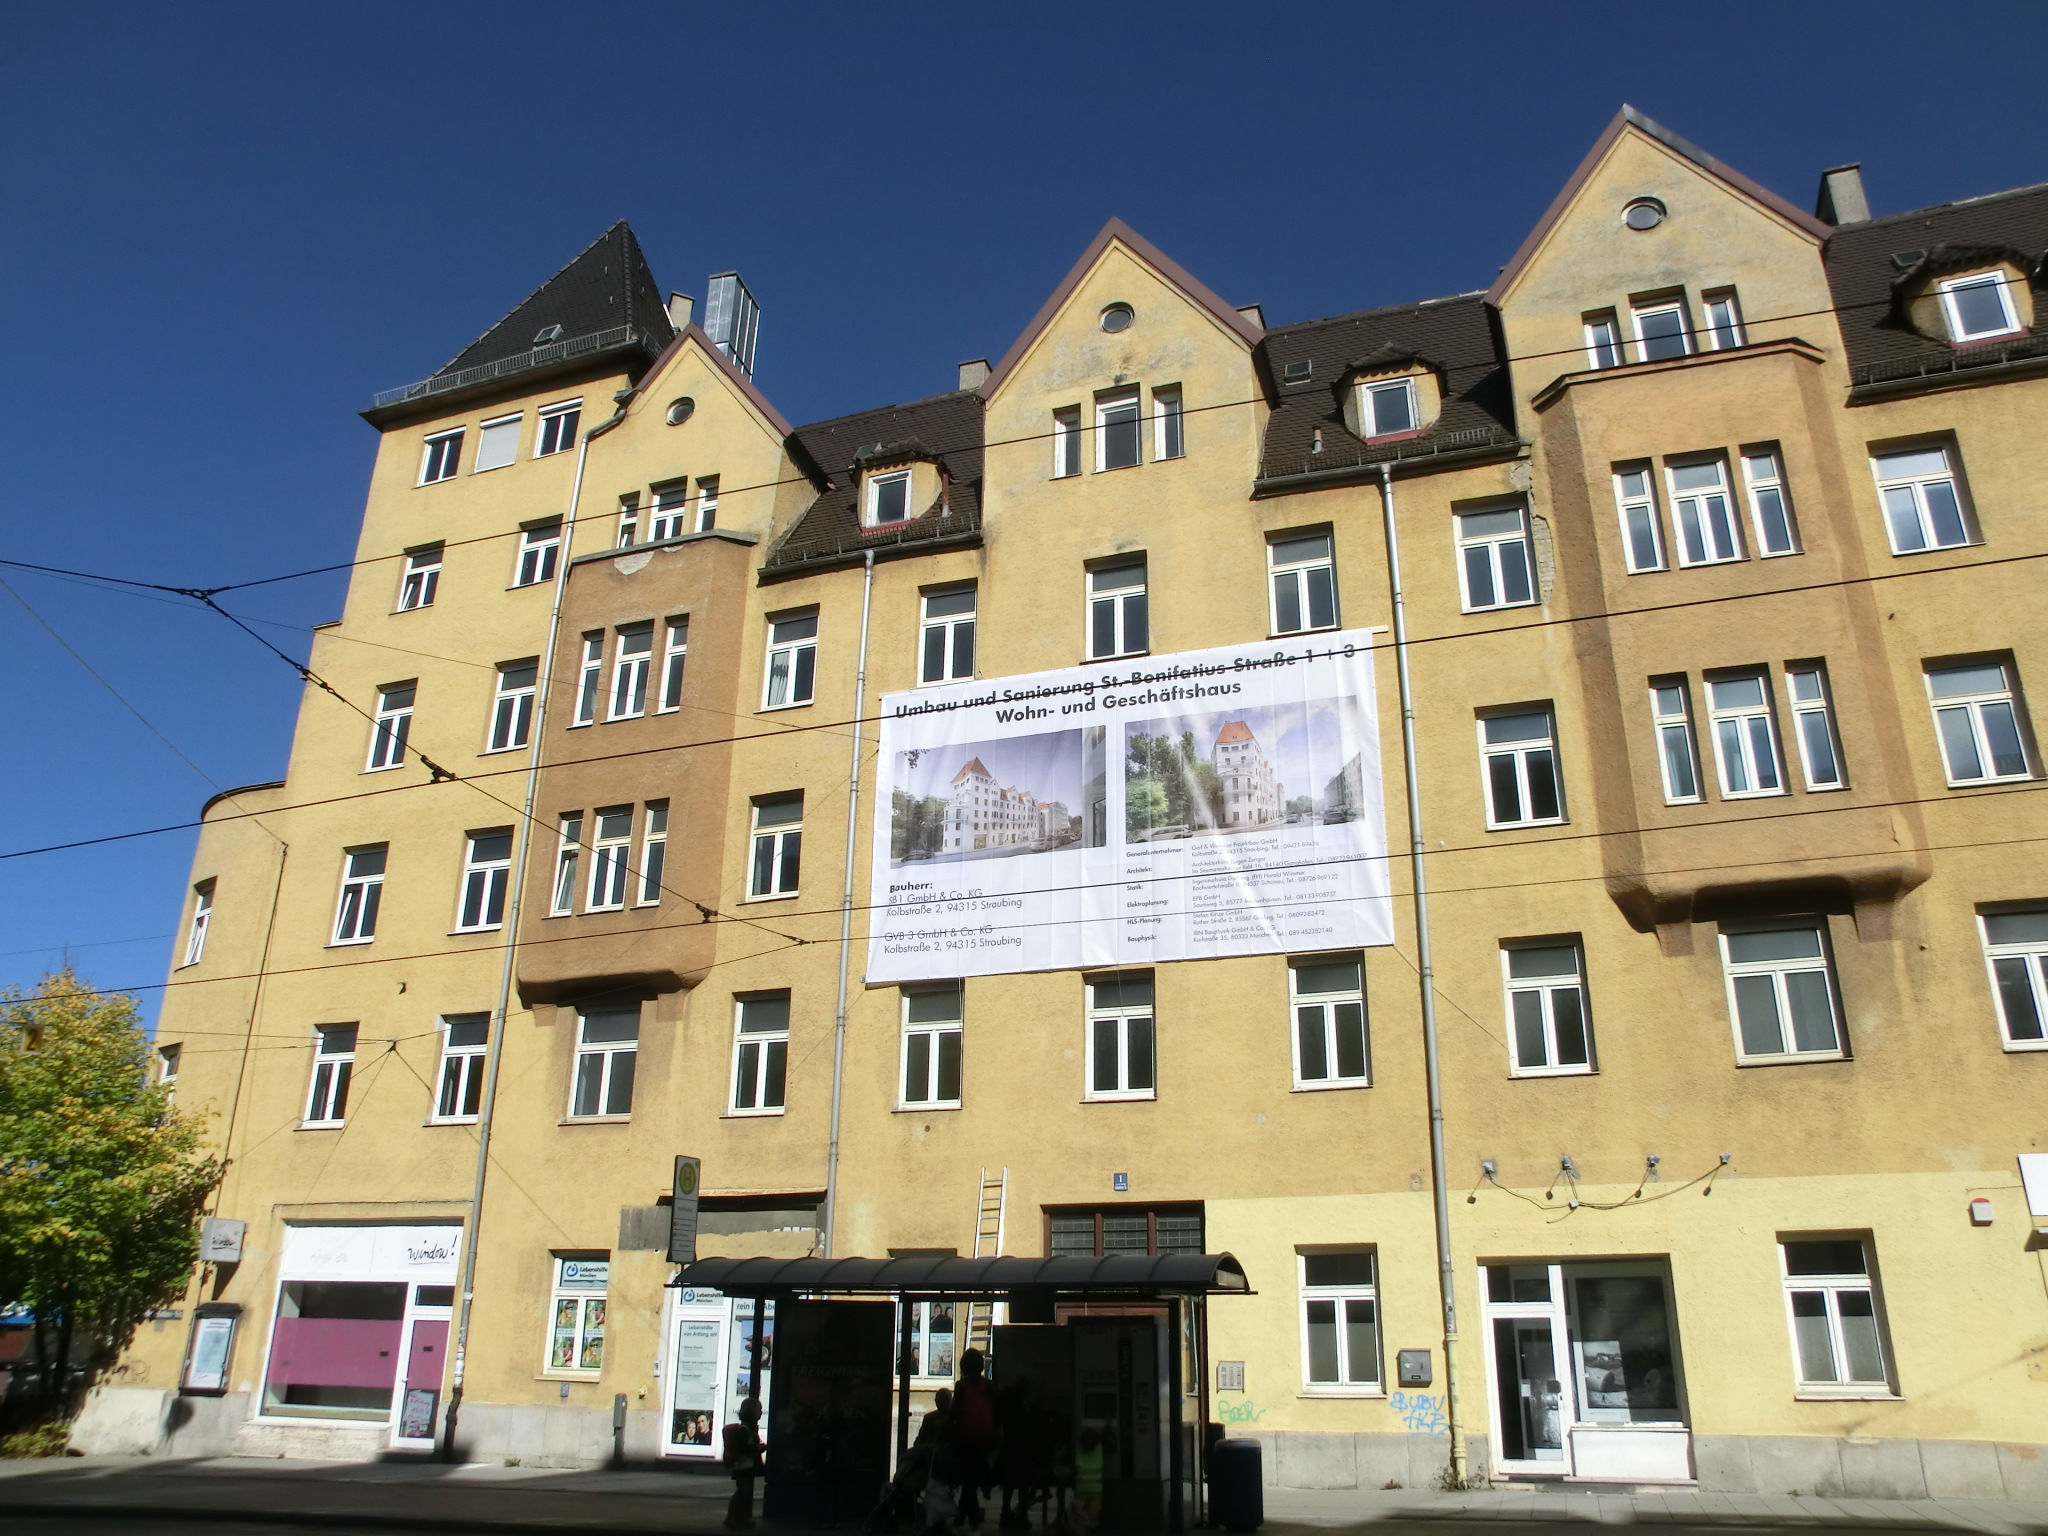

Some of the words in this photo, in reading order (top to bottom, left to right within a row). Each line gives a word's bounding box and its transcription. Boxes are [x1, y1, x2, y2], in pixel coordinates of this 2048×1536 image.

[896, 700, 957, 719] Umbau
[964, 691, 996, 707] und
[1003, 682, 1094, 702] Sanierung
[1305, 649, 1312, 662] 1
[1344, 644, 1355, 658] 3
[996, 704, 1054, 723] Wohn-
[1061, 696, 1096, 715] und
[1103, 682, 1241, 709] Geschäftshaus
[889, 881, 933, 893] Bauherr:
[907, 892, 936, 903] GmbH
[940, 891, 946, 901] &
[949, 890, 964, 900] Co.
[968, 888, 983, 898] KG
[886, 904, 932, 917] Kolbstraße
[935, 904, 943, 914] 2,
[947, 901, 977, 912] 94315
[981, 898, 1022, 910] Straubing
[908, 930, 914, 940] 3
[918, 929, 947, 939] GmbH
[950, 927, 957, 937] &
[961, 926, 976, 937] Co.
[980, 924, 993, 934] KG
[884, 942, 930, 954] Kolbstraße
[934, 941, 942, 952] 2,
[946, 938, 976, 950] 94315
[979, 936, 1021, 948] Straubing
[408, 1234, 457, 1261] window!
